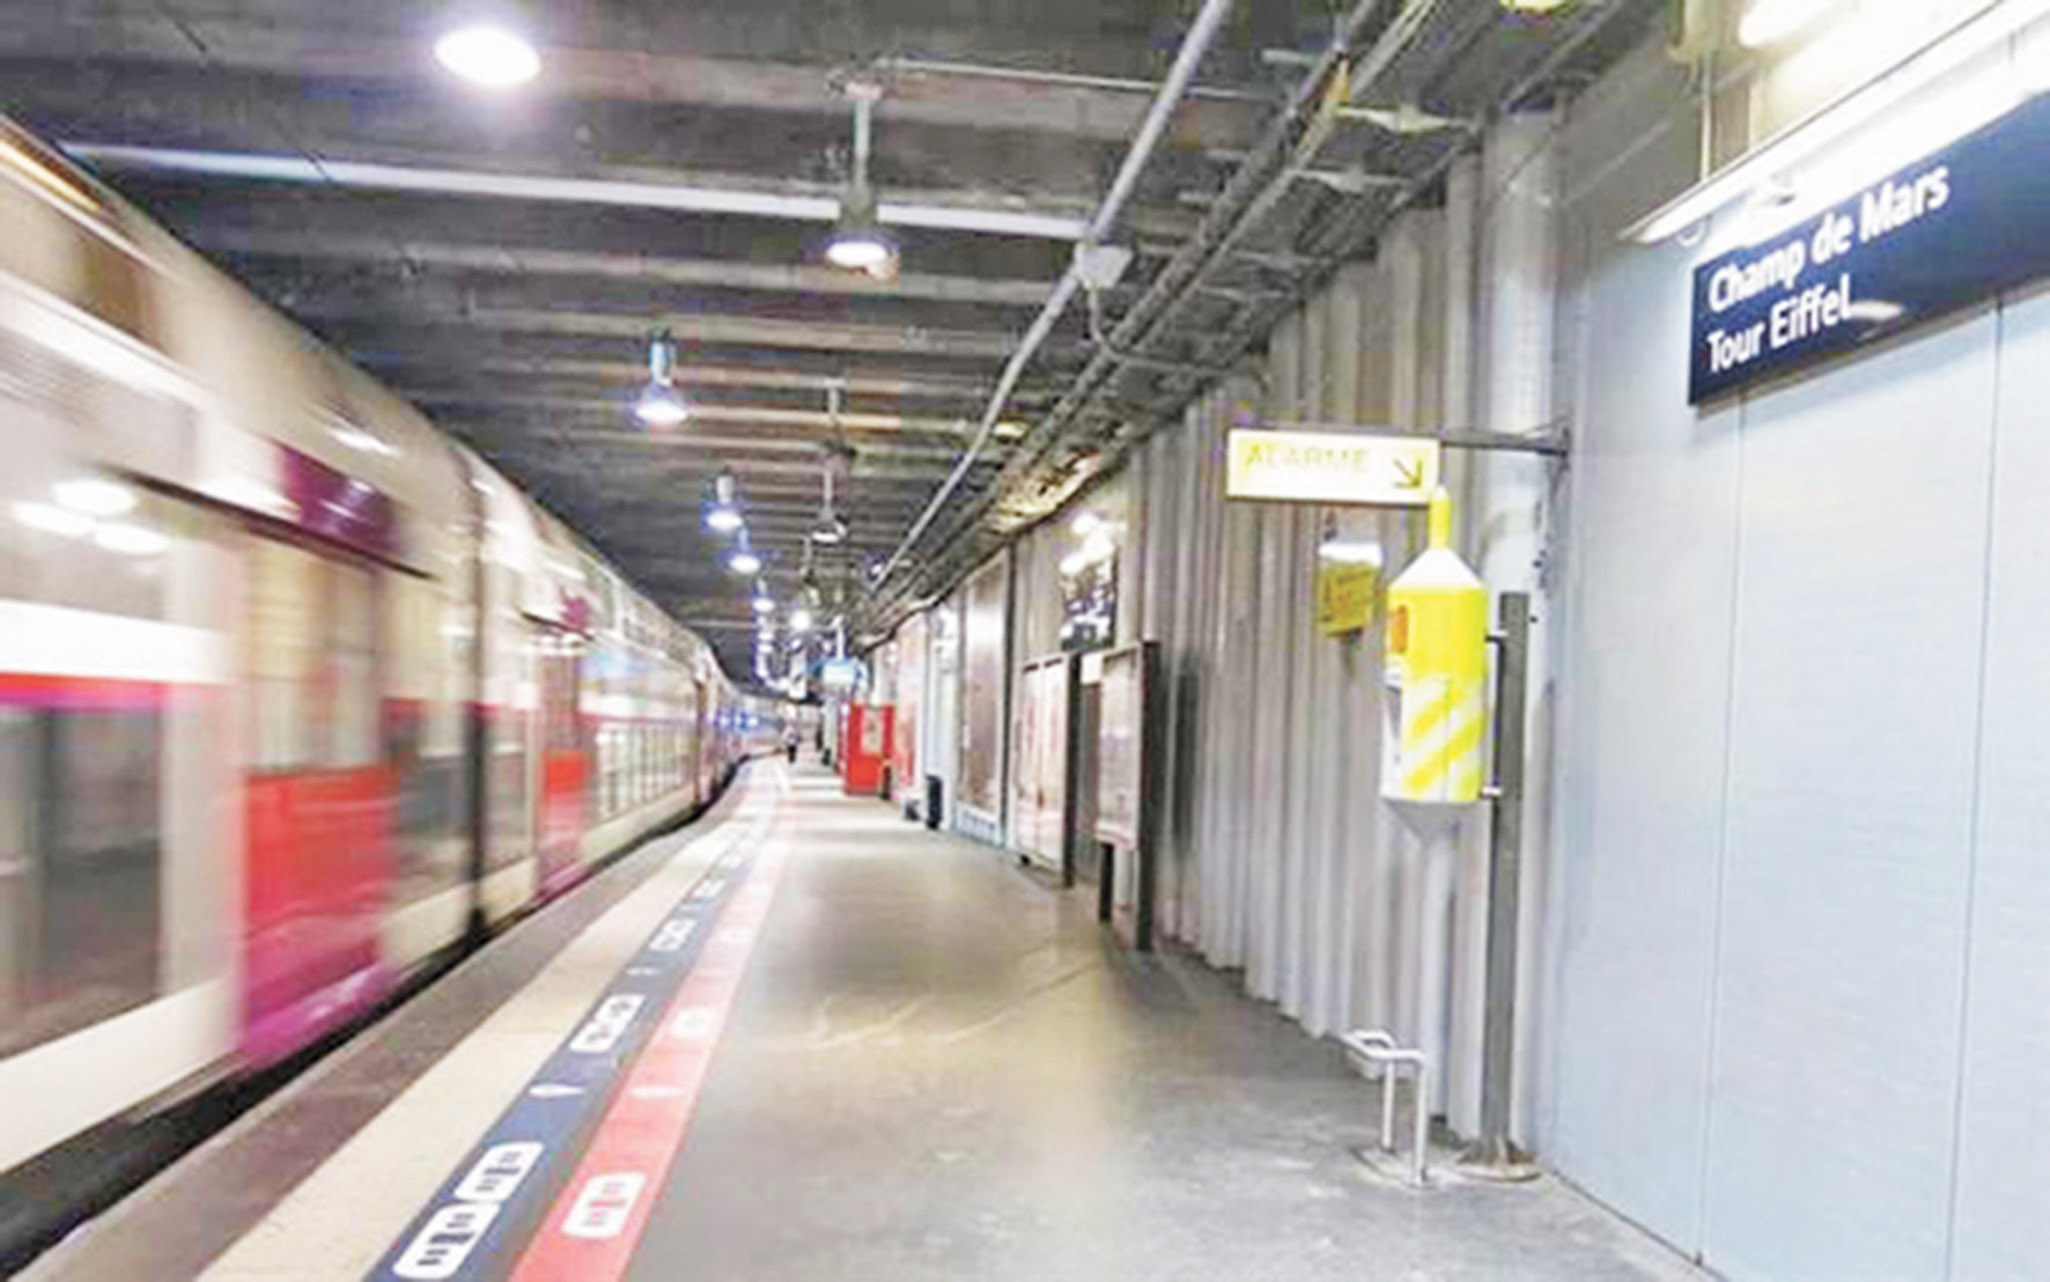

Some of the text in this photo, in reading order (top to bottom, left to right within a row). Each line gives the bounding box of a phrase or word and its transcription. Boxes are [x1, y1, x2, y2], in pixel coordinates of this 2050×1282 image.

[1709, 166, 1949, 312] Champ de Mars
[1706, 273, 1851, 373] Tour Eiffel
[1245, 442, 1370, 470] ALARME
